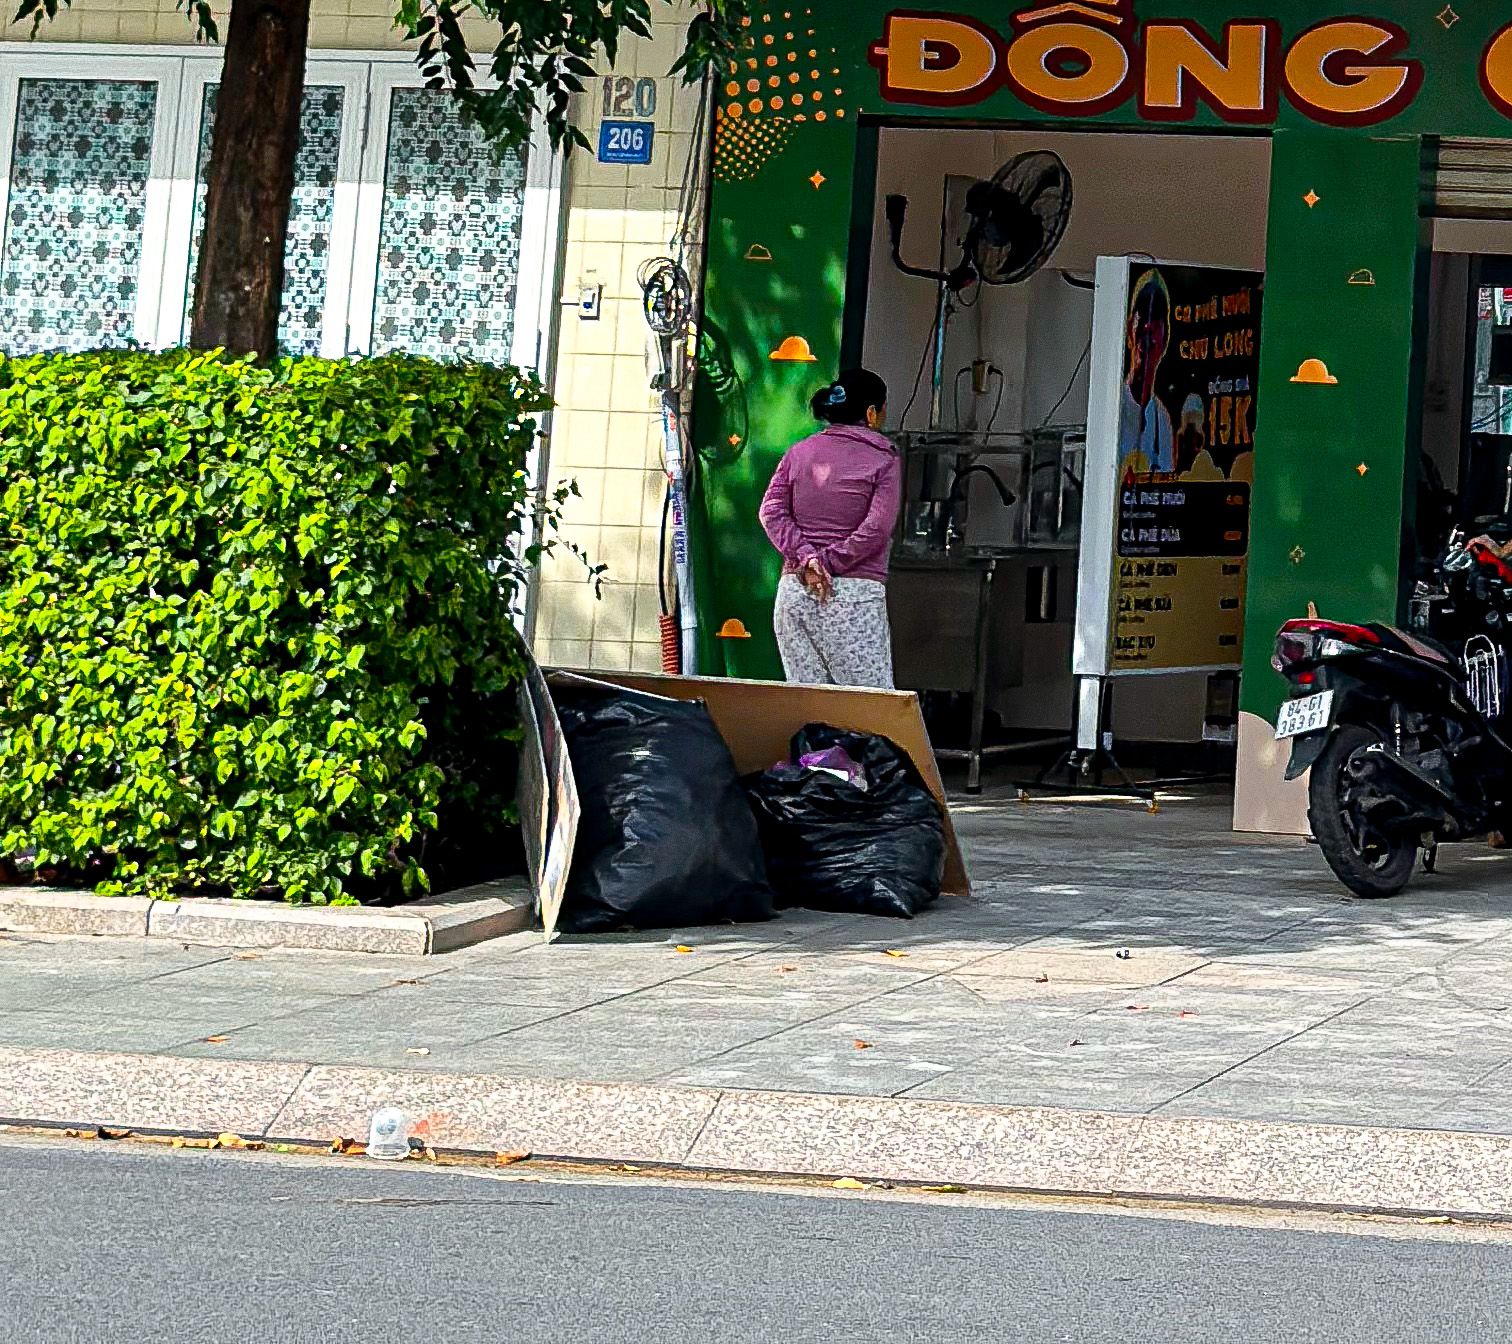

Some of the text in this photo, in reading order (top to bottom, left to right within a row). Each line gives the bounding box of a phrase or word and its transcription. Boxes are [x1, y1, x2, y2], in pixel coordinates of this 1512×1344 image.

[602, 75, 657, 118] 120
[607, 127, 644, 151] 206
[1213, 328, 1254, 360] LONG
[1208, 395, 1252, 447] 15K
